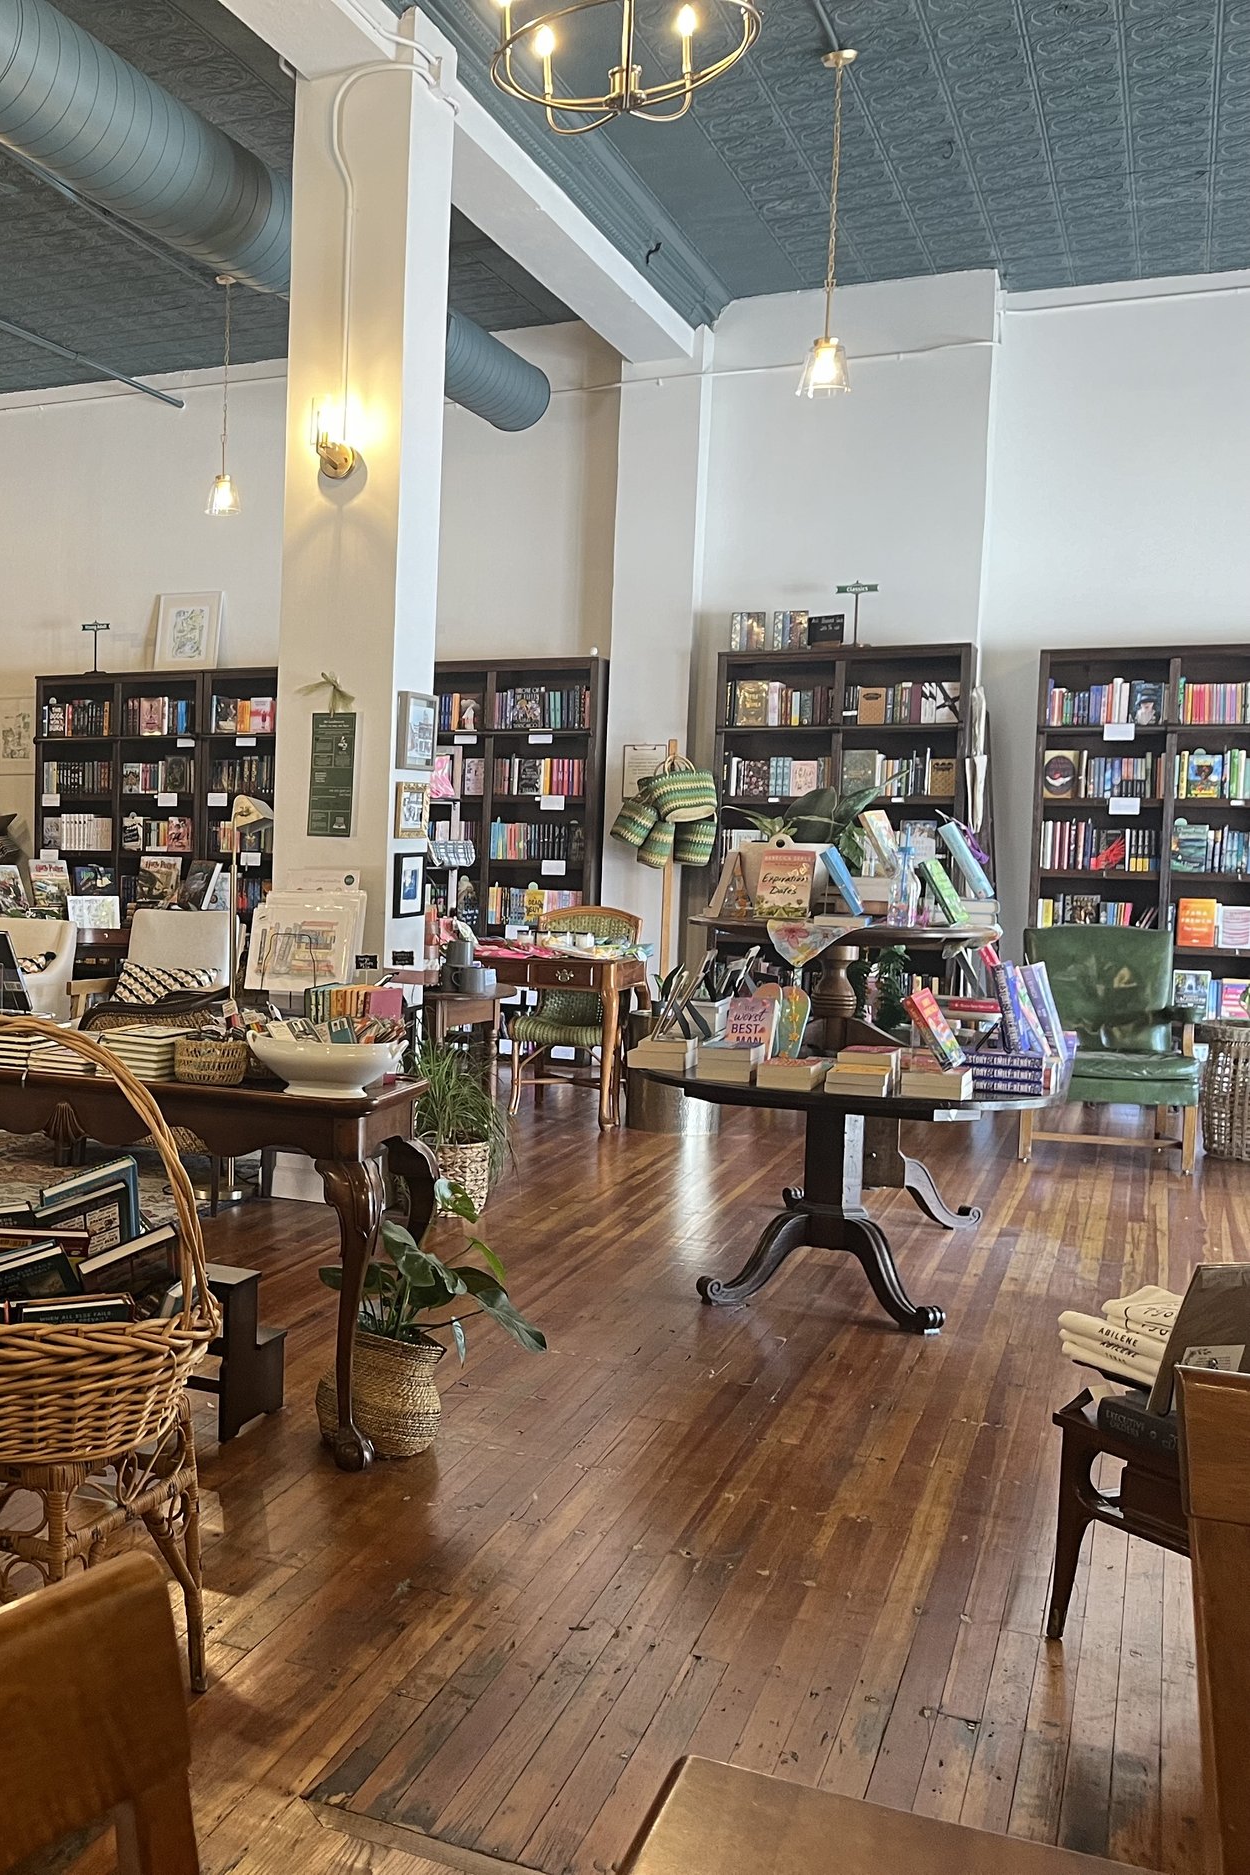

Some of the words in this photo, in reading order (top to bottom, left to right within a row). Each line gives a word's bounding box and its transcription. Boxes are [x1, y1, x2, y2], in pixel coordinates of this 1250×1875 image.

[769, 886, 797, 895] Dates
[734, 1008, 767, 1022] worst
[731, 1023, 760, 1034] BEST
[1098, 1327, 1139, 1347] ABILENE
[1105, 1409, 1144, 1431] EXECUTIVE
